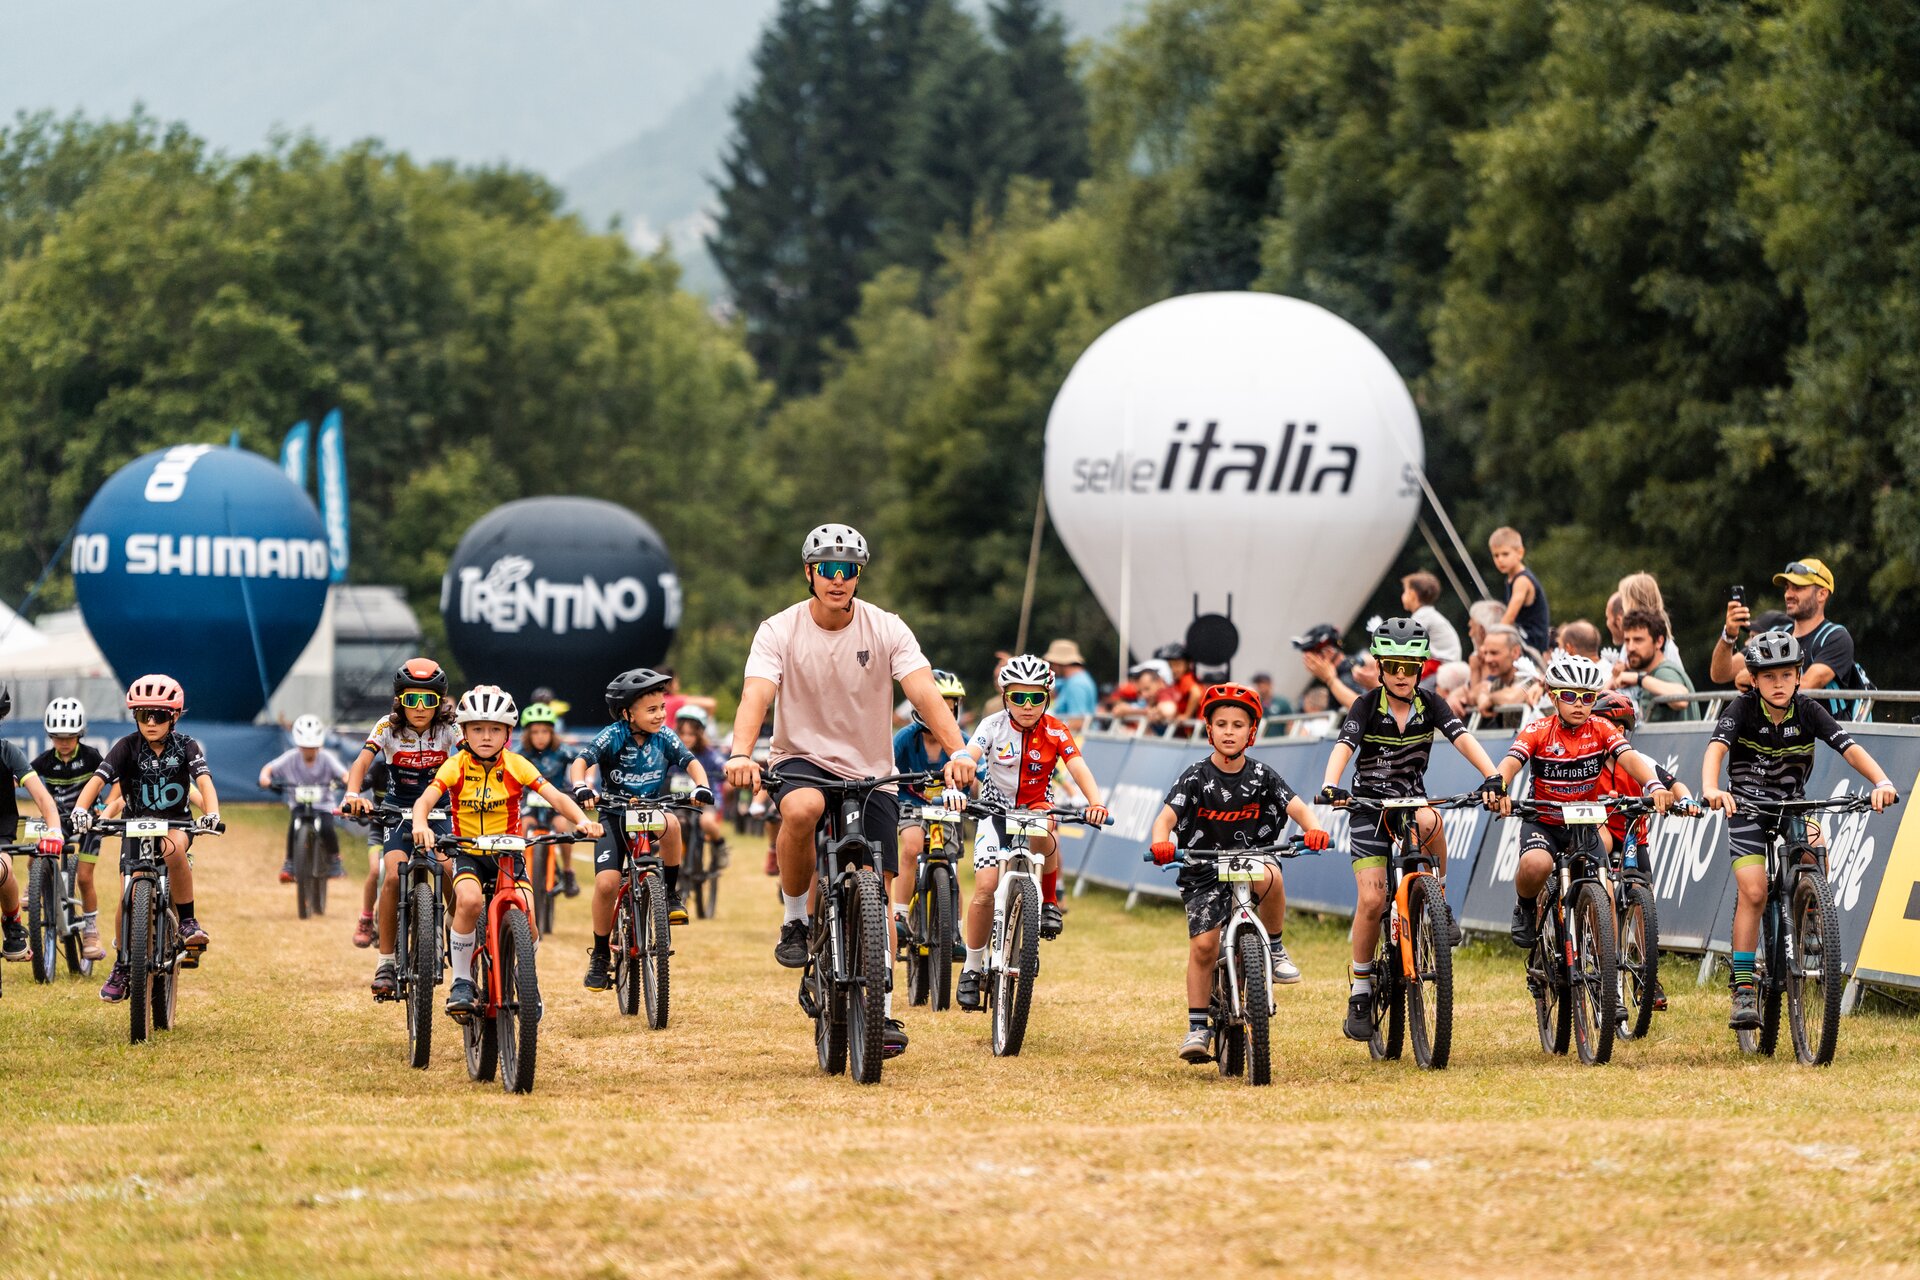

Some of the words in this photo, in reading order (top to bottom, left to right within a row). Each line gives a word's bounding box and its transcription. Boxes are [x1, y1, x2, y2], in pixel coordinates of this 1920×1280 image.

[1157, 420, 1360, 495] italia
[125, 533, 329, 580] SHIMANO
[459, 565, 648, 635] TRENTINO
[1543, 764, 1600, 778] SANFIORESE
[637, 811, 653, 823] 81
[1197, 803, 1261, 822] GHOST
[1575, 808, 1594, 817] 71
[34, 824, 48, 832] 66
[137, 822, 157, 830] 63
[1229, 857, 1254, 872] 64
[1648, 805, 1726, 908] NTINO
[1783, 933, 1795, 960] FOX
